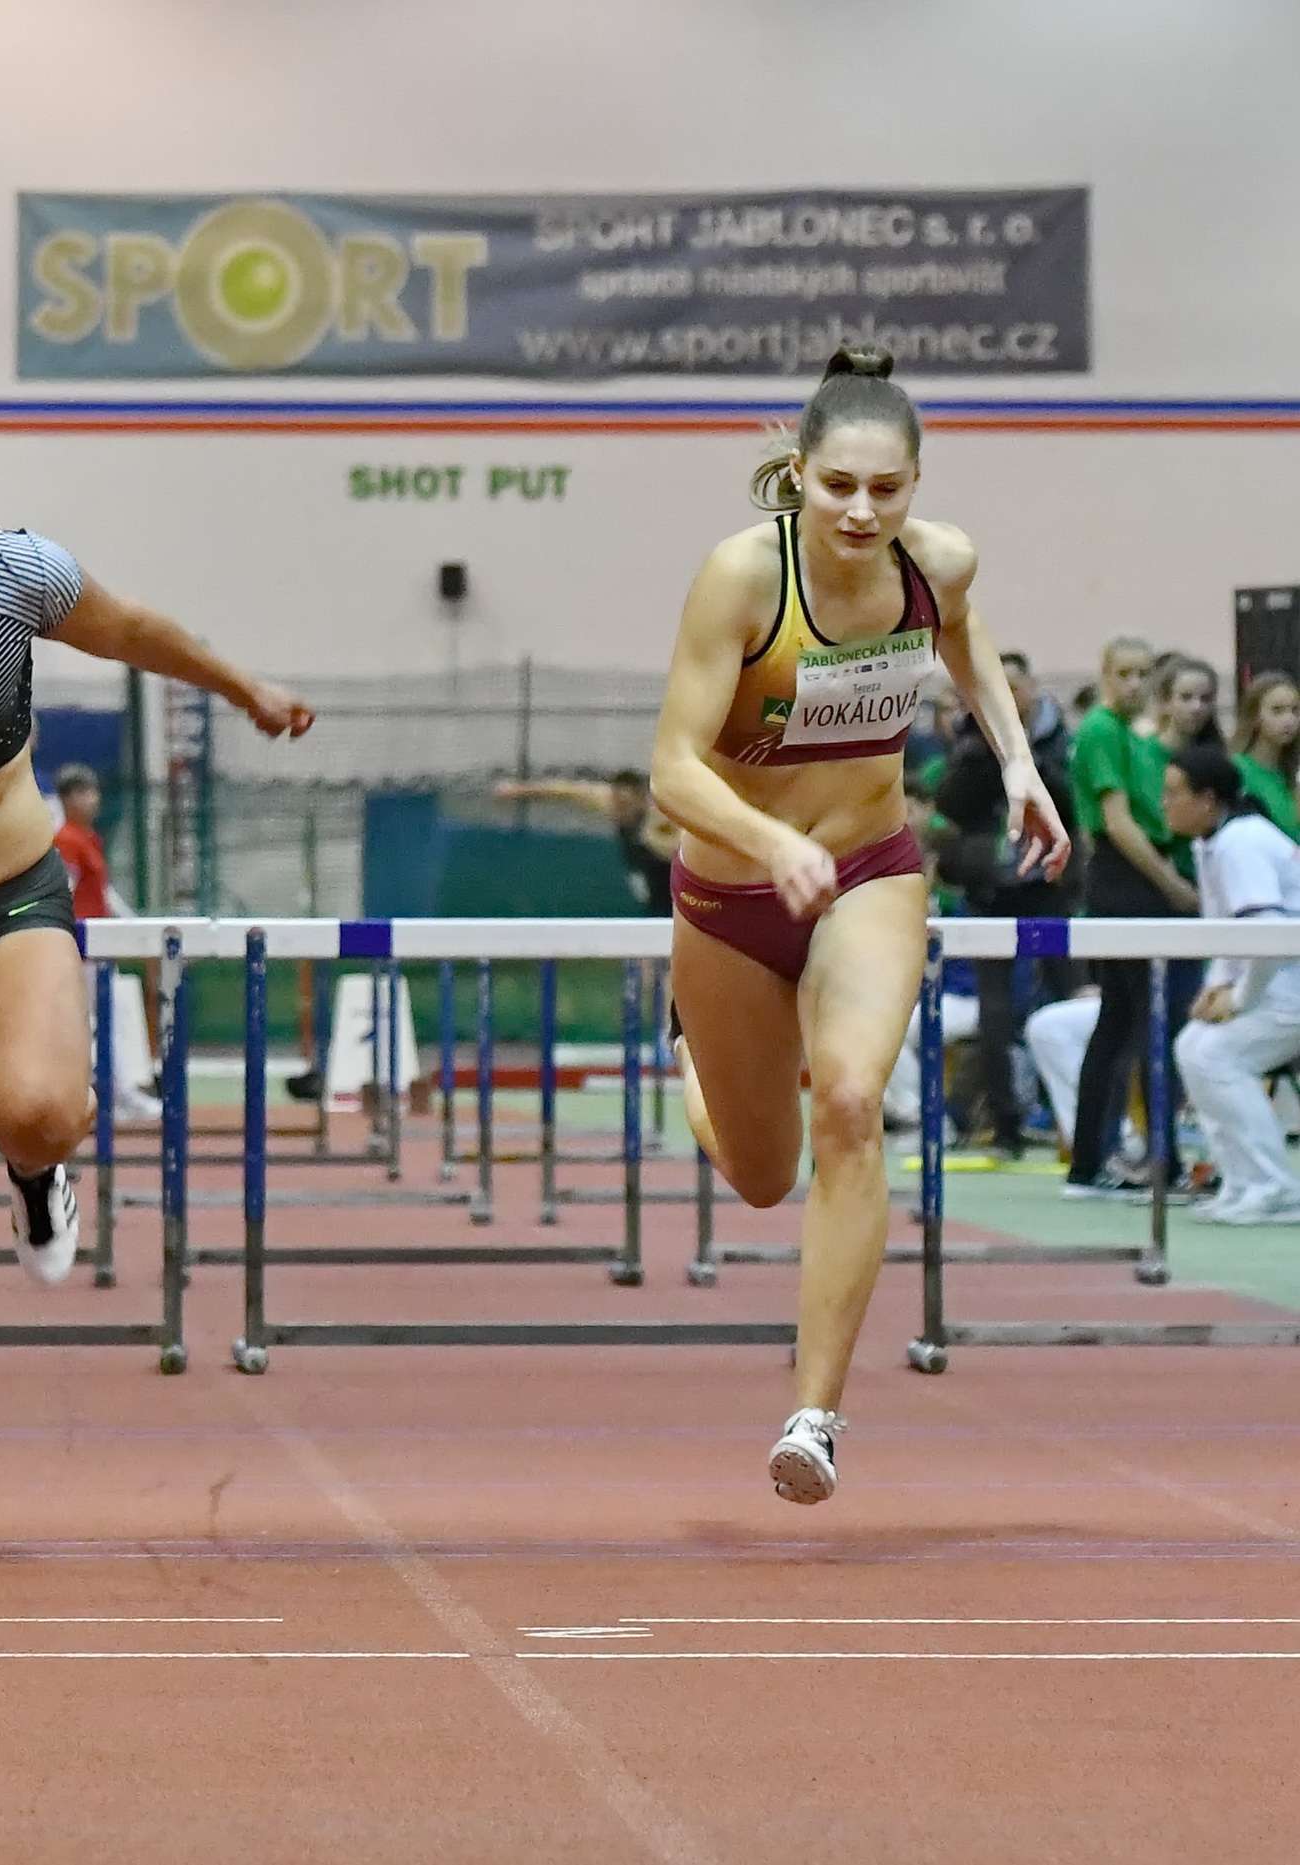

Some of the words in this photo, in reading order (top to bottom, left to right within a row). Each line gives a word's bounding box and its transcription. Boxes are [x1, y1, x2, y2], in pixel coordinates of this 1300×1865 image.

[533, 205, 674, 250] SPORT
[690, 203, 916, 249] JABLONEC
[32, 199, 488, 370] SPORT
[516, 314, 1059, 374] www.sportjablonec.cz
[349, 466, 462, 500] SHOT
[489, 465, 573, 499] PUT
[892, 637, 925, 654] HALA
[803, 683, 920, 728] VOKÁLOVÁ
